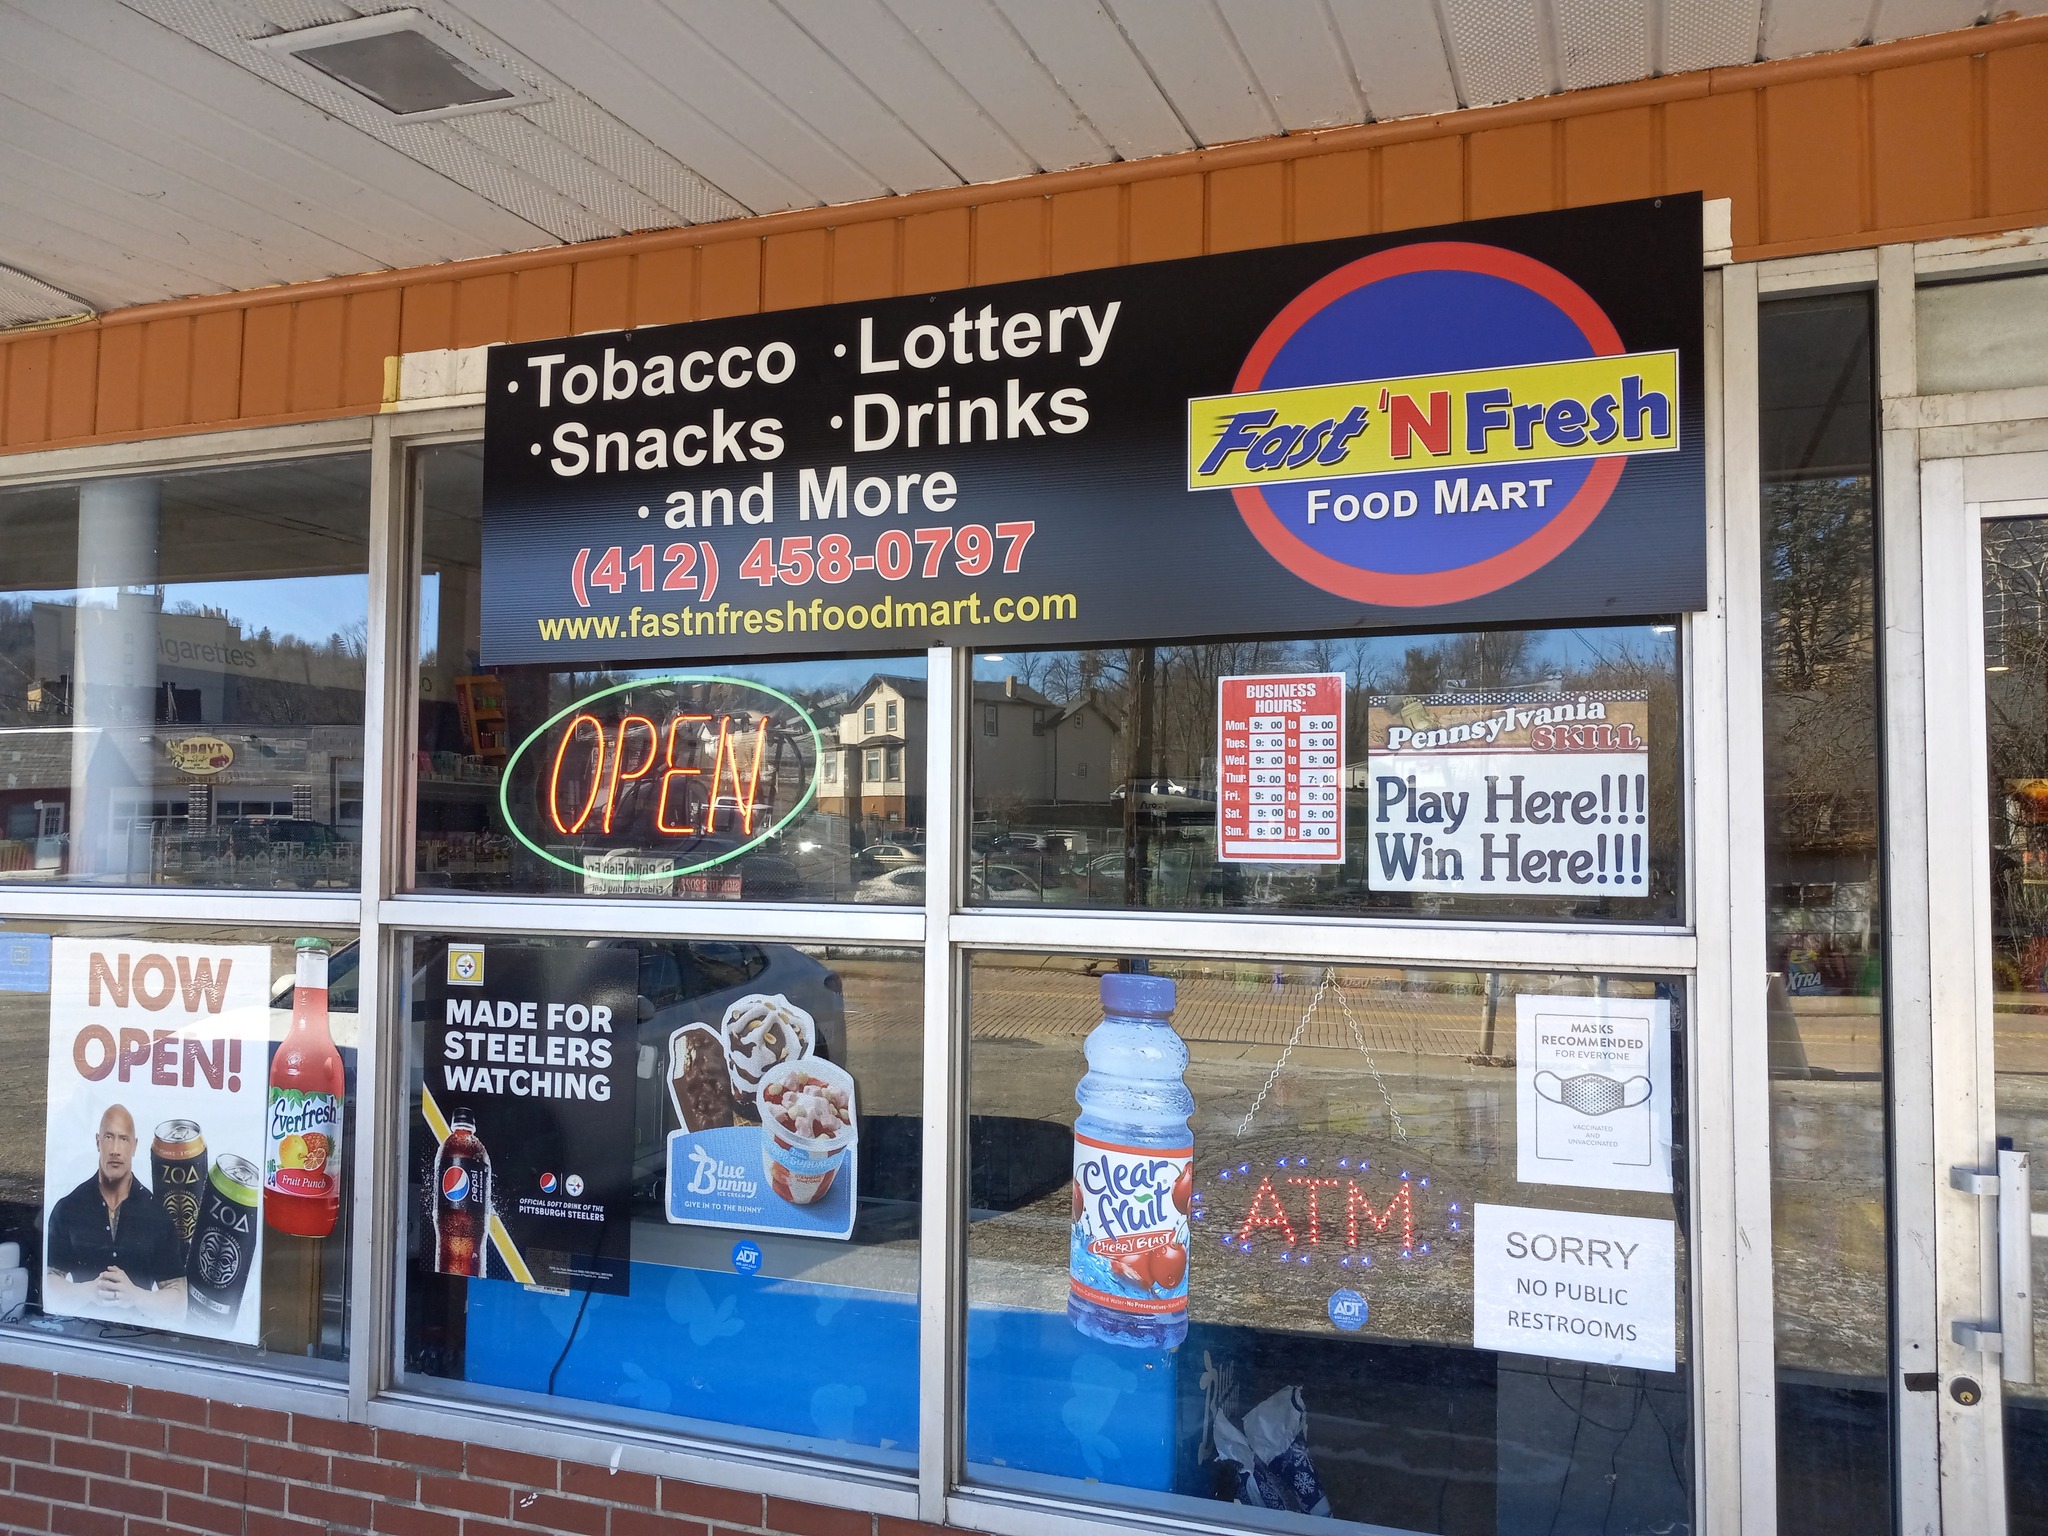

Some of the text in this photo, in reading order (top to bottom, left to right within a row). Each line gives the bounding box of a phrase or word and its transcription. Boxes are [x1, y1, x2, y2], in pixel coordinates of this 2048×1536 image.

[860, 301, 1122, 374] Lottery
[527, 338, 797, 407] Tobacco
[853, 379, 1090, 452] Drinks
[1197, 406, 1369, 475] Fast
[1464, 375, 1671, 453] Fresh
[550, 408, 785, 476] Snacks
[664, 466, 957, 530] and More
[572, 520, 1035, 607] (412) 458-0797
[538, 590, 1077, 641] www.fastnfreshfoodmart.com
[157, 633, 256, 669] igarettes
[1246, 683, 1317, 698] BUSINESS
[1255, 700, 1306, 713] HOURS:
[1225, 720, 1248, 731] Mon.
[1288, 720, 1296, 729] to
[1387, 696, 1605, 750] Pennsylvania
[1531, 723, 1642, 750] SKILL
[1225, 738, 1248, 748] Tues.
[1288, 737, 1296, 747] to
[549, 712, 769, 836] OPEN
[1225, 755, 1247, 765] Wed.
[1288, 755, 1296, 765] to
[1225, 773, 1247, 783] Thur.
[1288, 773, 1296, 783] to
[1225, 791, 1240, 801] Fri.
[1288, 790, 1296, 800] to
[1375, 774, 1646, 834] Play Here!!!
[1225, 808, 1242, 818] Sat.
[1288, 808, 1296, 818] to
[1225, 826, 1244, 836] Sun.
[1288, 826, 1296, 836] to
[1375, 832, 1642, 884] Win Here!!!
[88, 952, 232, 1013] NOW
[1788, 971, 1821, 990] XTRA
[446, 999, 612, 1033] MADE FOR
[1571, 1023, 1614, 1034] MASKS
[73, 1023, 242, 1093] OPEN!
[444, 1031, 612, 1069] STEELERS
[1541, 1035, 1643, 1049] RECOMMENDED
[1555, 1050, 1629, 1060] FOR EVERYONE
[443, 1065, 611, 1102] WATCHING
[272, 1096, 336, 1140] Everfresh
[1572, 1124, 1613, 1132] VACCINATED
[1568, 1139, 1618, 1147] UNVACCINATED
[162, 1165, 200, 1184] ZOA
[282, 1175, 326, 1189] Fruit Punch
[470, 1169, 479, 1203] pepsi
[210, 1195, 250, 1233] ZOA
[519, 1198, 546, 1206] OFFICIAL
[547, 1200, 563, 1208] SOFT
[563, 1202, 582, 1210] DRINK
[519, 1205, 605, 1222] PITTSBURGH STEELERS
[737, 1205, 762, 1213] BUNNY
[1098, 1182, 1171, 1241] fruit
[1239, 1176, 1413, 1249] ATM
[736, 1250, 758, 1264] ADT
[1506, 1231, 1639, 1270] SORRY
[1517, 1278, 1628, 1306] NO PUBLIC
[1333, 1301, 1362, 1316] ADT
[1508, 1310, 1637, 1342] RESTROOMS
